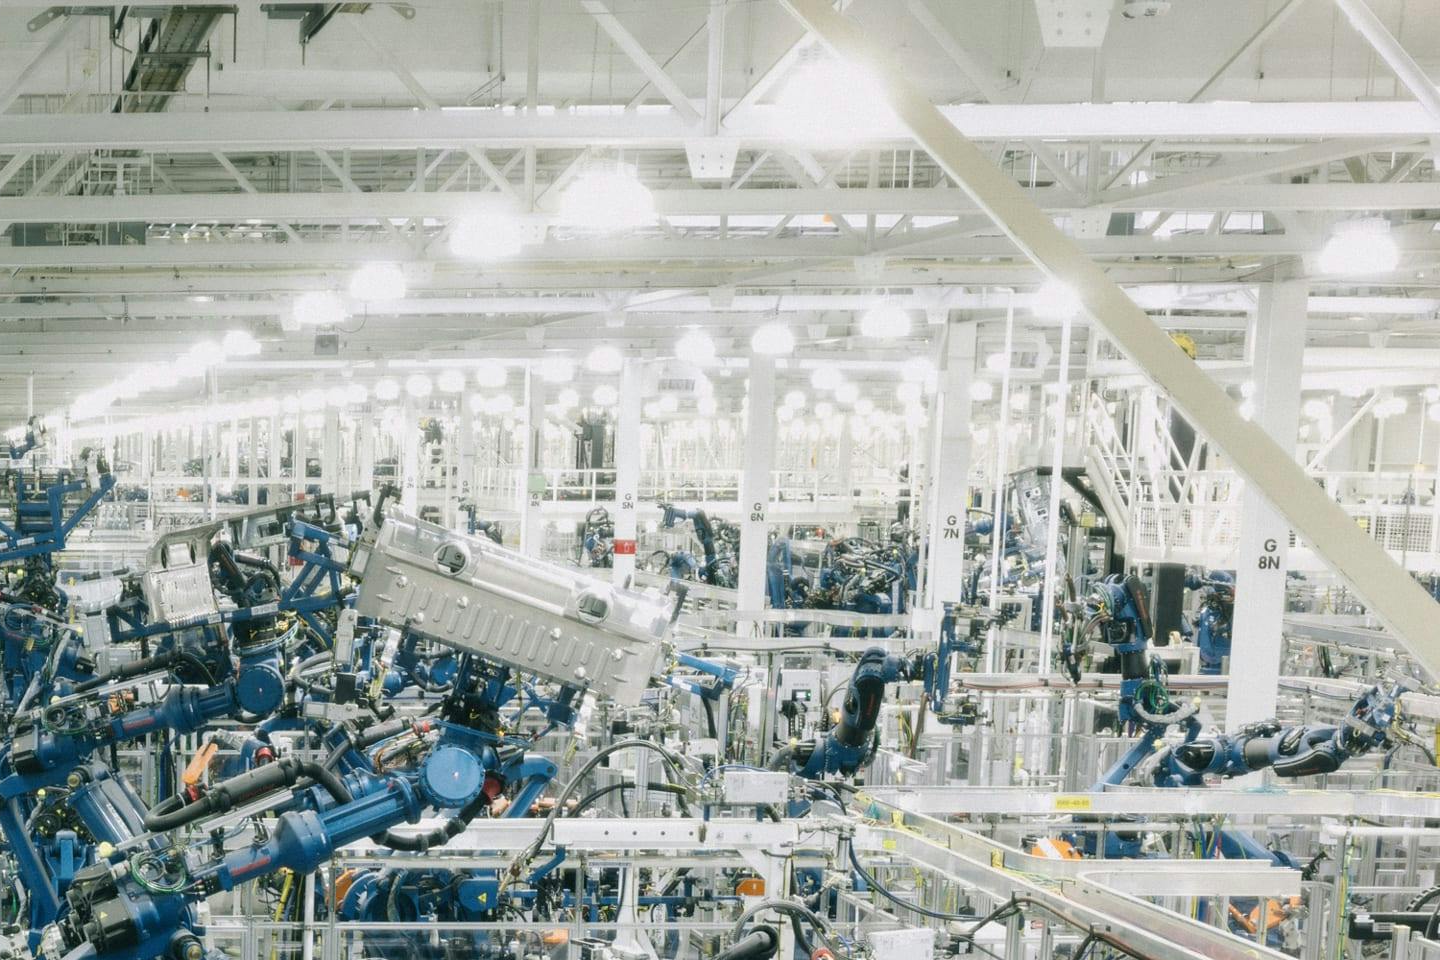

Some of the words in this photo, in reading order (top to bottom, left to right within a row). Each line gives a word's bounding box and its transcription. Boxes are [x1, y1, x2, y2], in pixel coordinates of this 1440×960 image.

[753, 503, 762, 512] G
[750, 513, 764, 521] 6N
[947, 515, 957, 526] G
[943, 528, 960, 539] 7N
[1264, 538, 1277, 553] G
[1258, 555, 1280, 570] 8N
